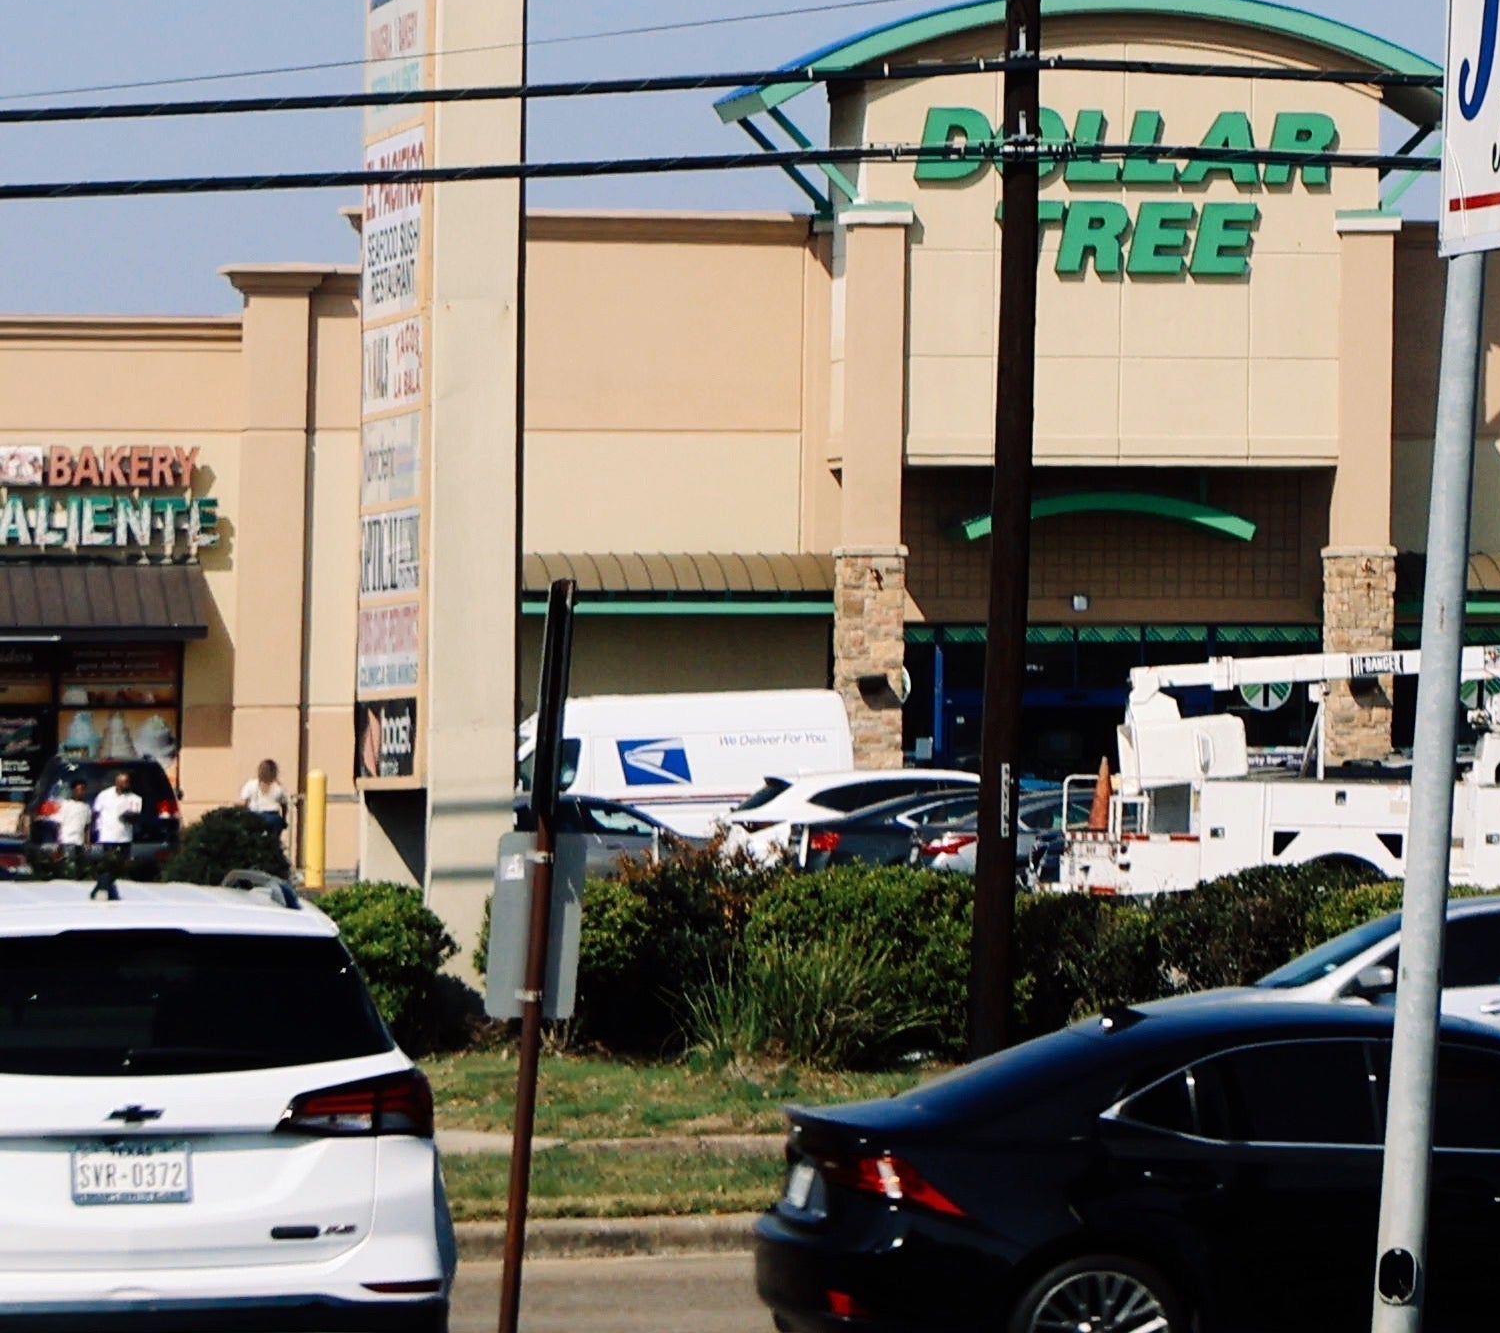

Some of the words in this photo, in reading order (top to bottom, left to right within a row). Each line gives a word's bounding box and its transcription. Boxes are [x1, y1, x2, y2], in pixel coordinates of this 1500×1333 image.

[48, 446, 200, 487] BAKERY
[0, 493, 220, 547] ALIENTE
[79, 1162, 183, 1188] SVR-0372
